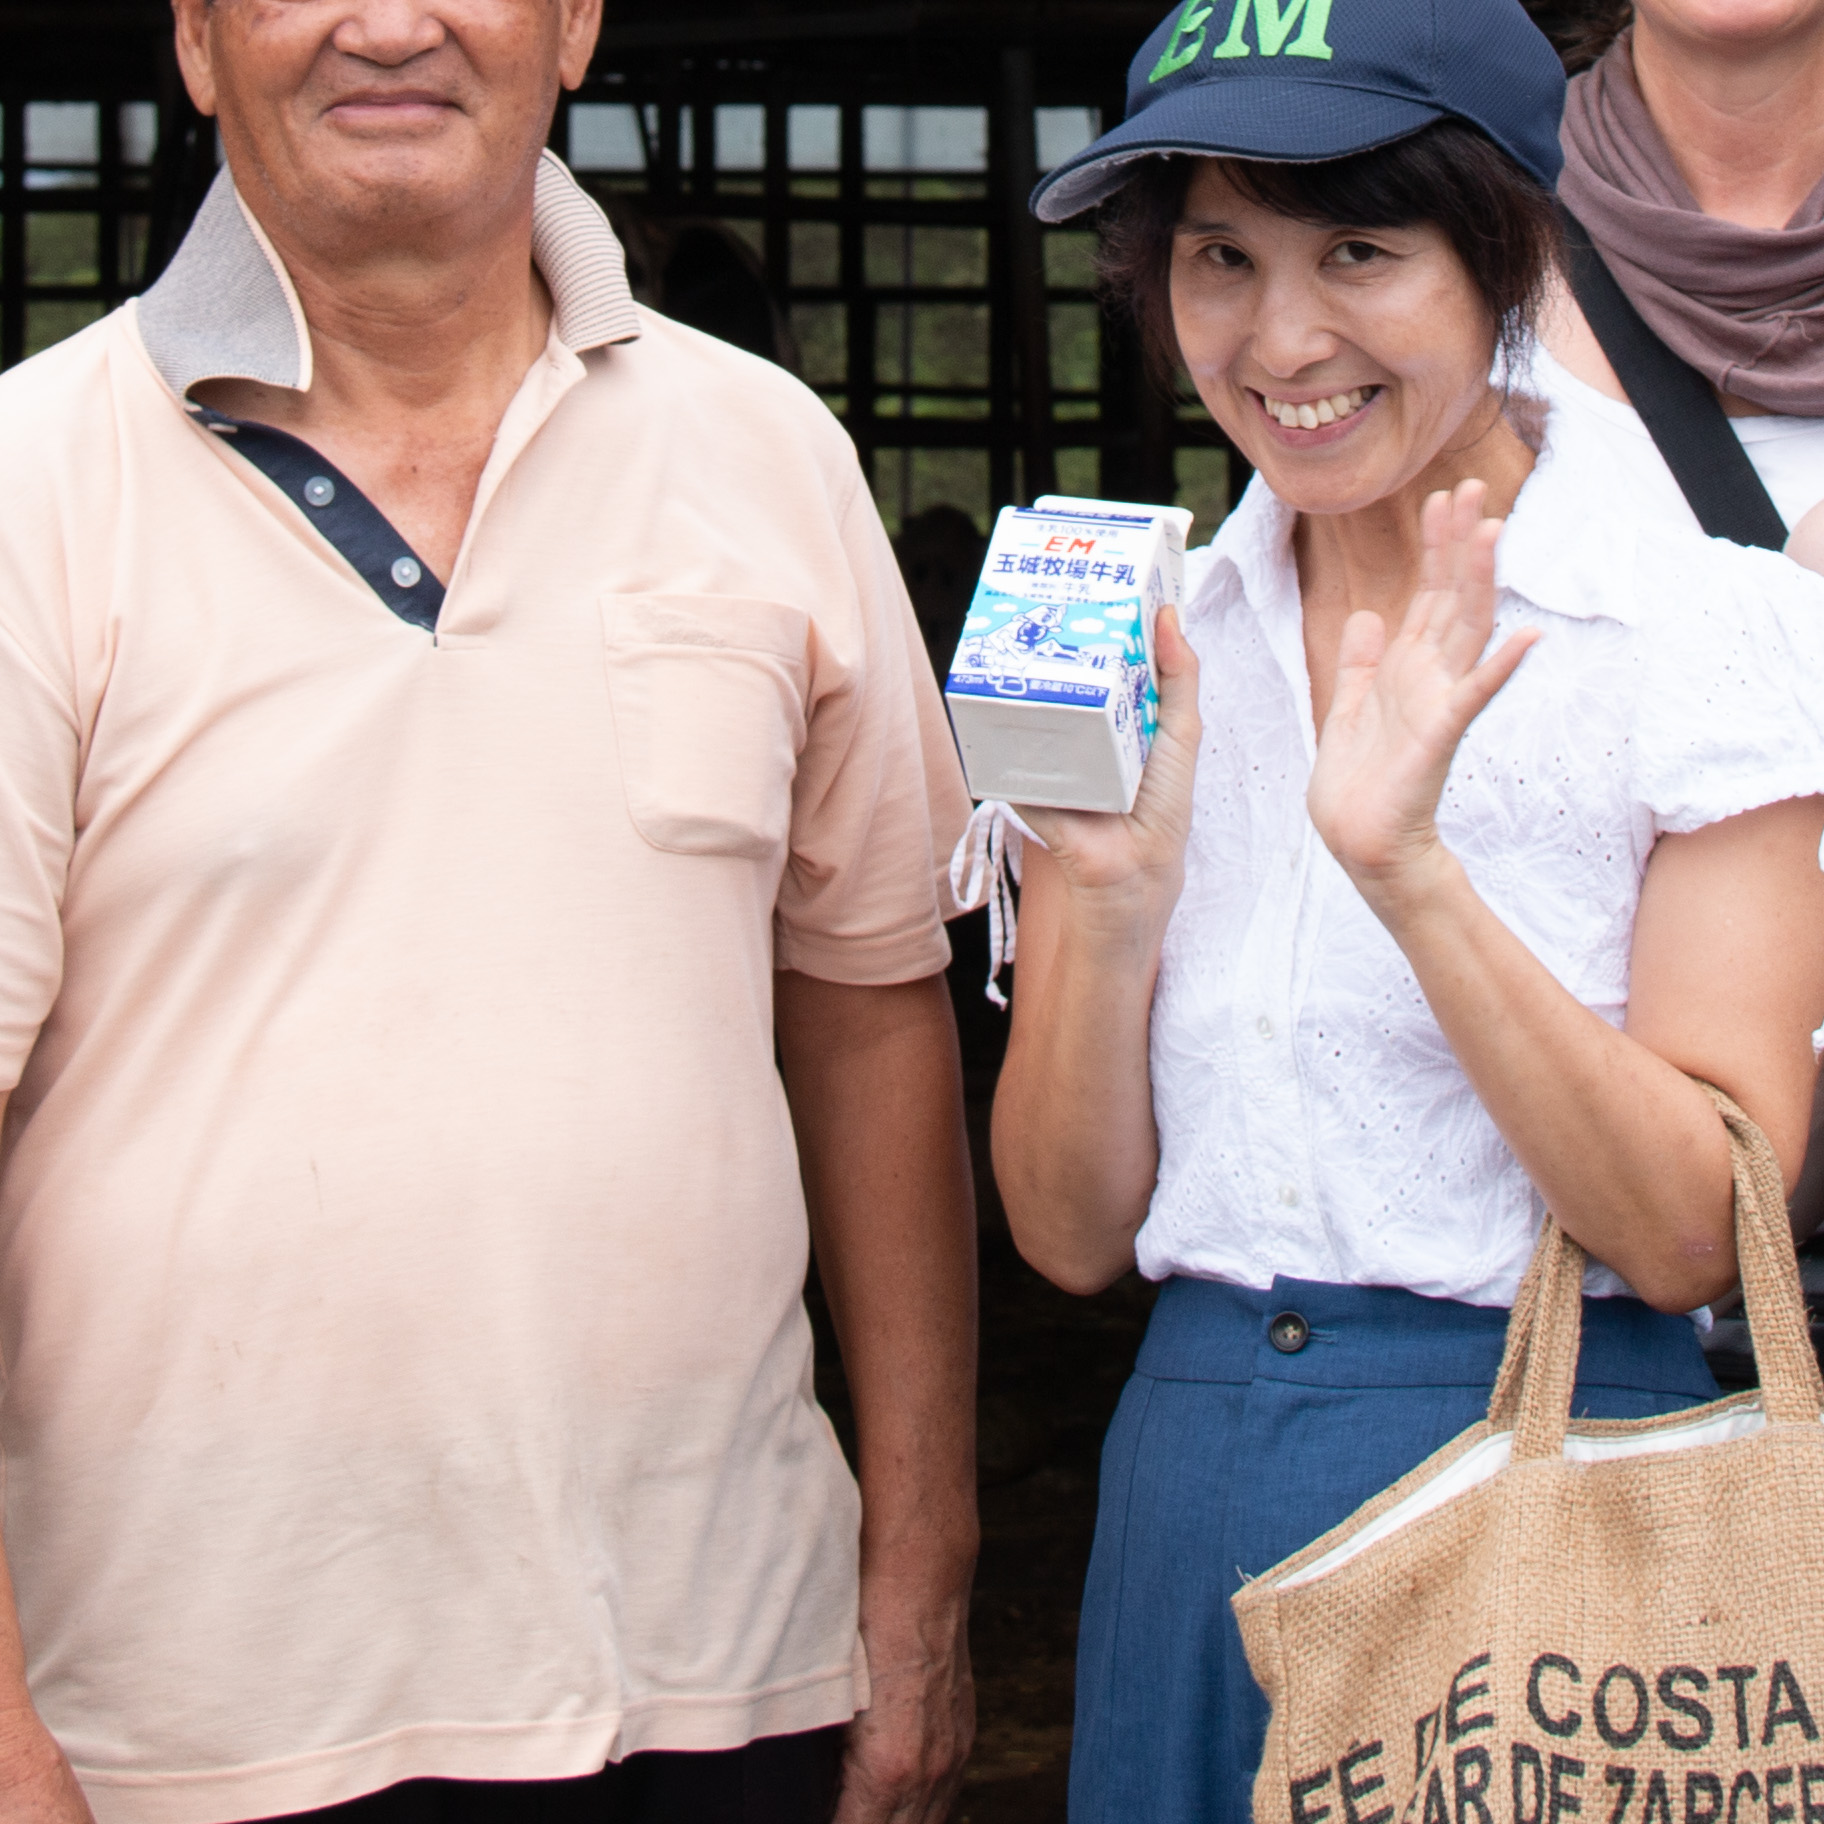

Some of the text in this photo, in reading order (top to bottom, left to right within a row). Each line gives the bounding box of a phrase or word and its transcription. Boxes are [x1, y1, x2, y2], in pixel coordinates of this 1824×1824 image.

[1044, 535, 1097, 555] EM
[992, 553, 1136, 587] 玉城牧場牛乳
[1526, 1651, 1820, 1752] COSTA
